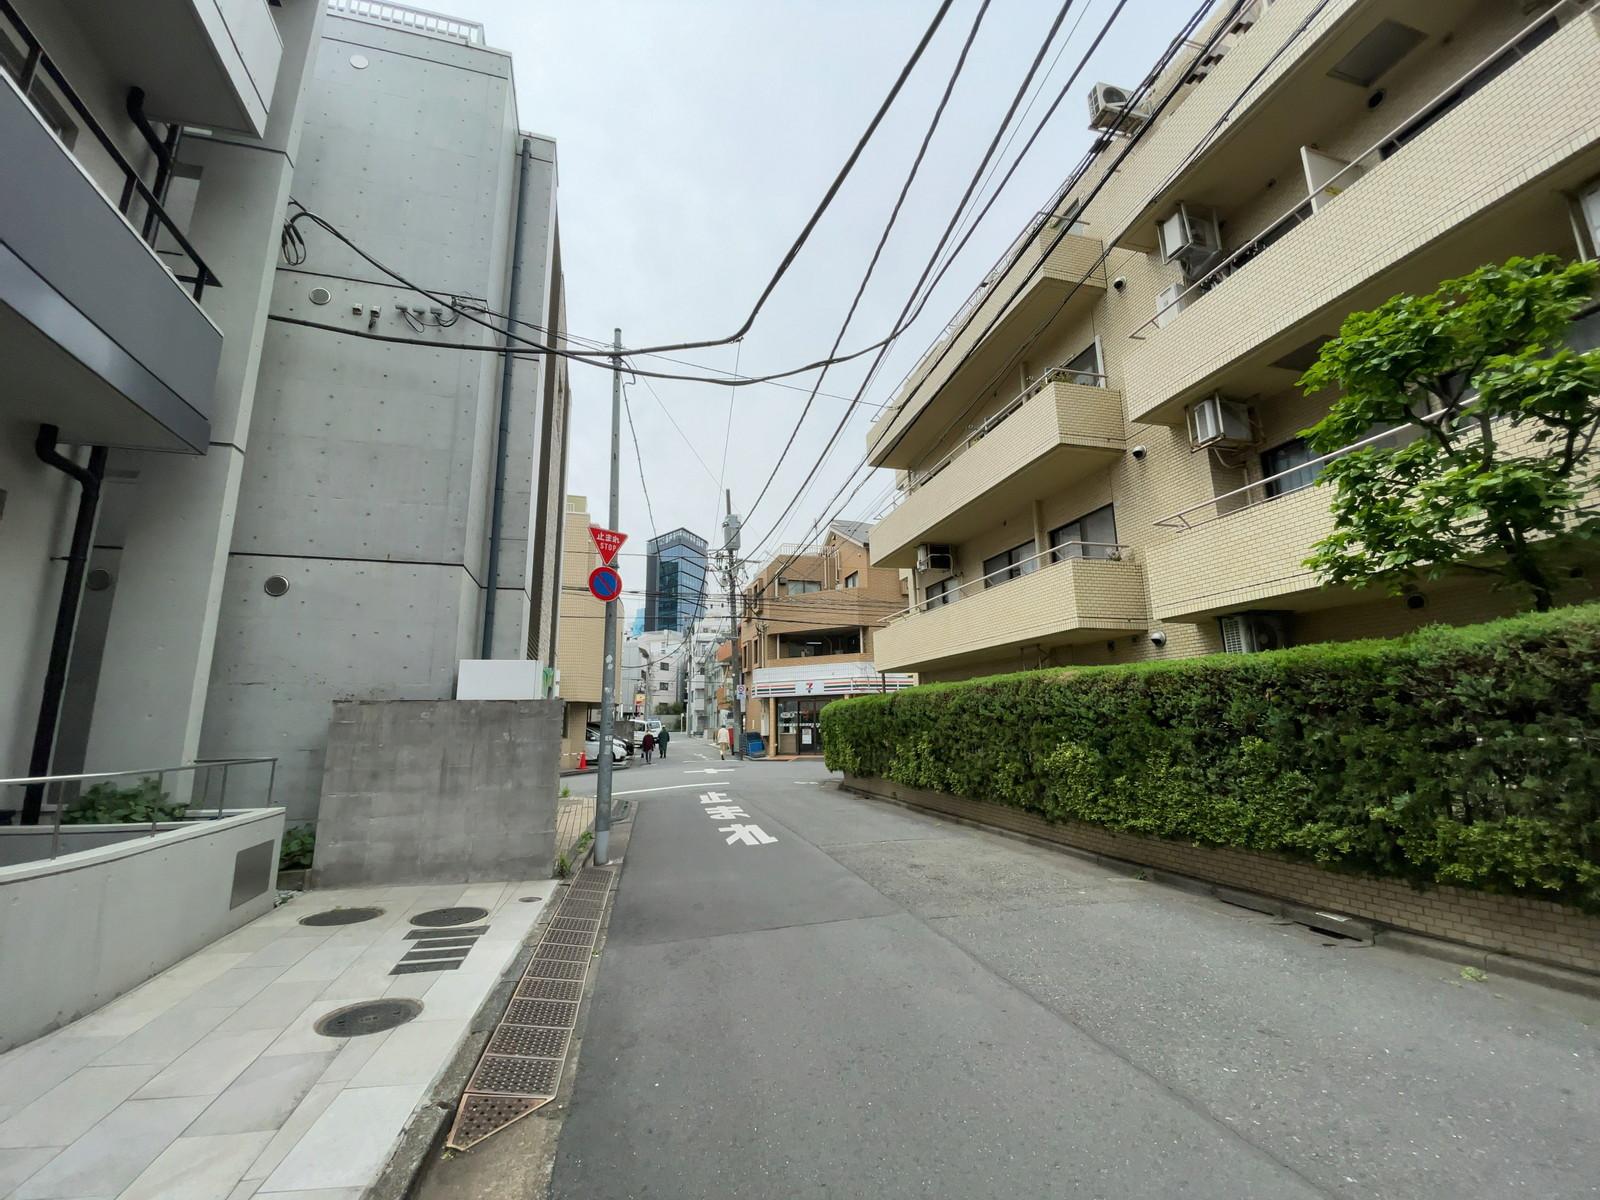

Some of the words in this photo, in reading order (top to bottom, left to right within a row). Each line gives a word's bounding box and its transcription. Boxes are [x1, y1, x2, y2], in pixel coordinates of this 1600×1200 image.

[596, 532, 620, 544] 止まれ
[600, 542, 616, 551] STOP
[699, 791, 779, 846] 止まれ
